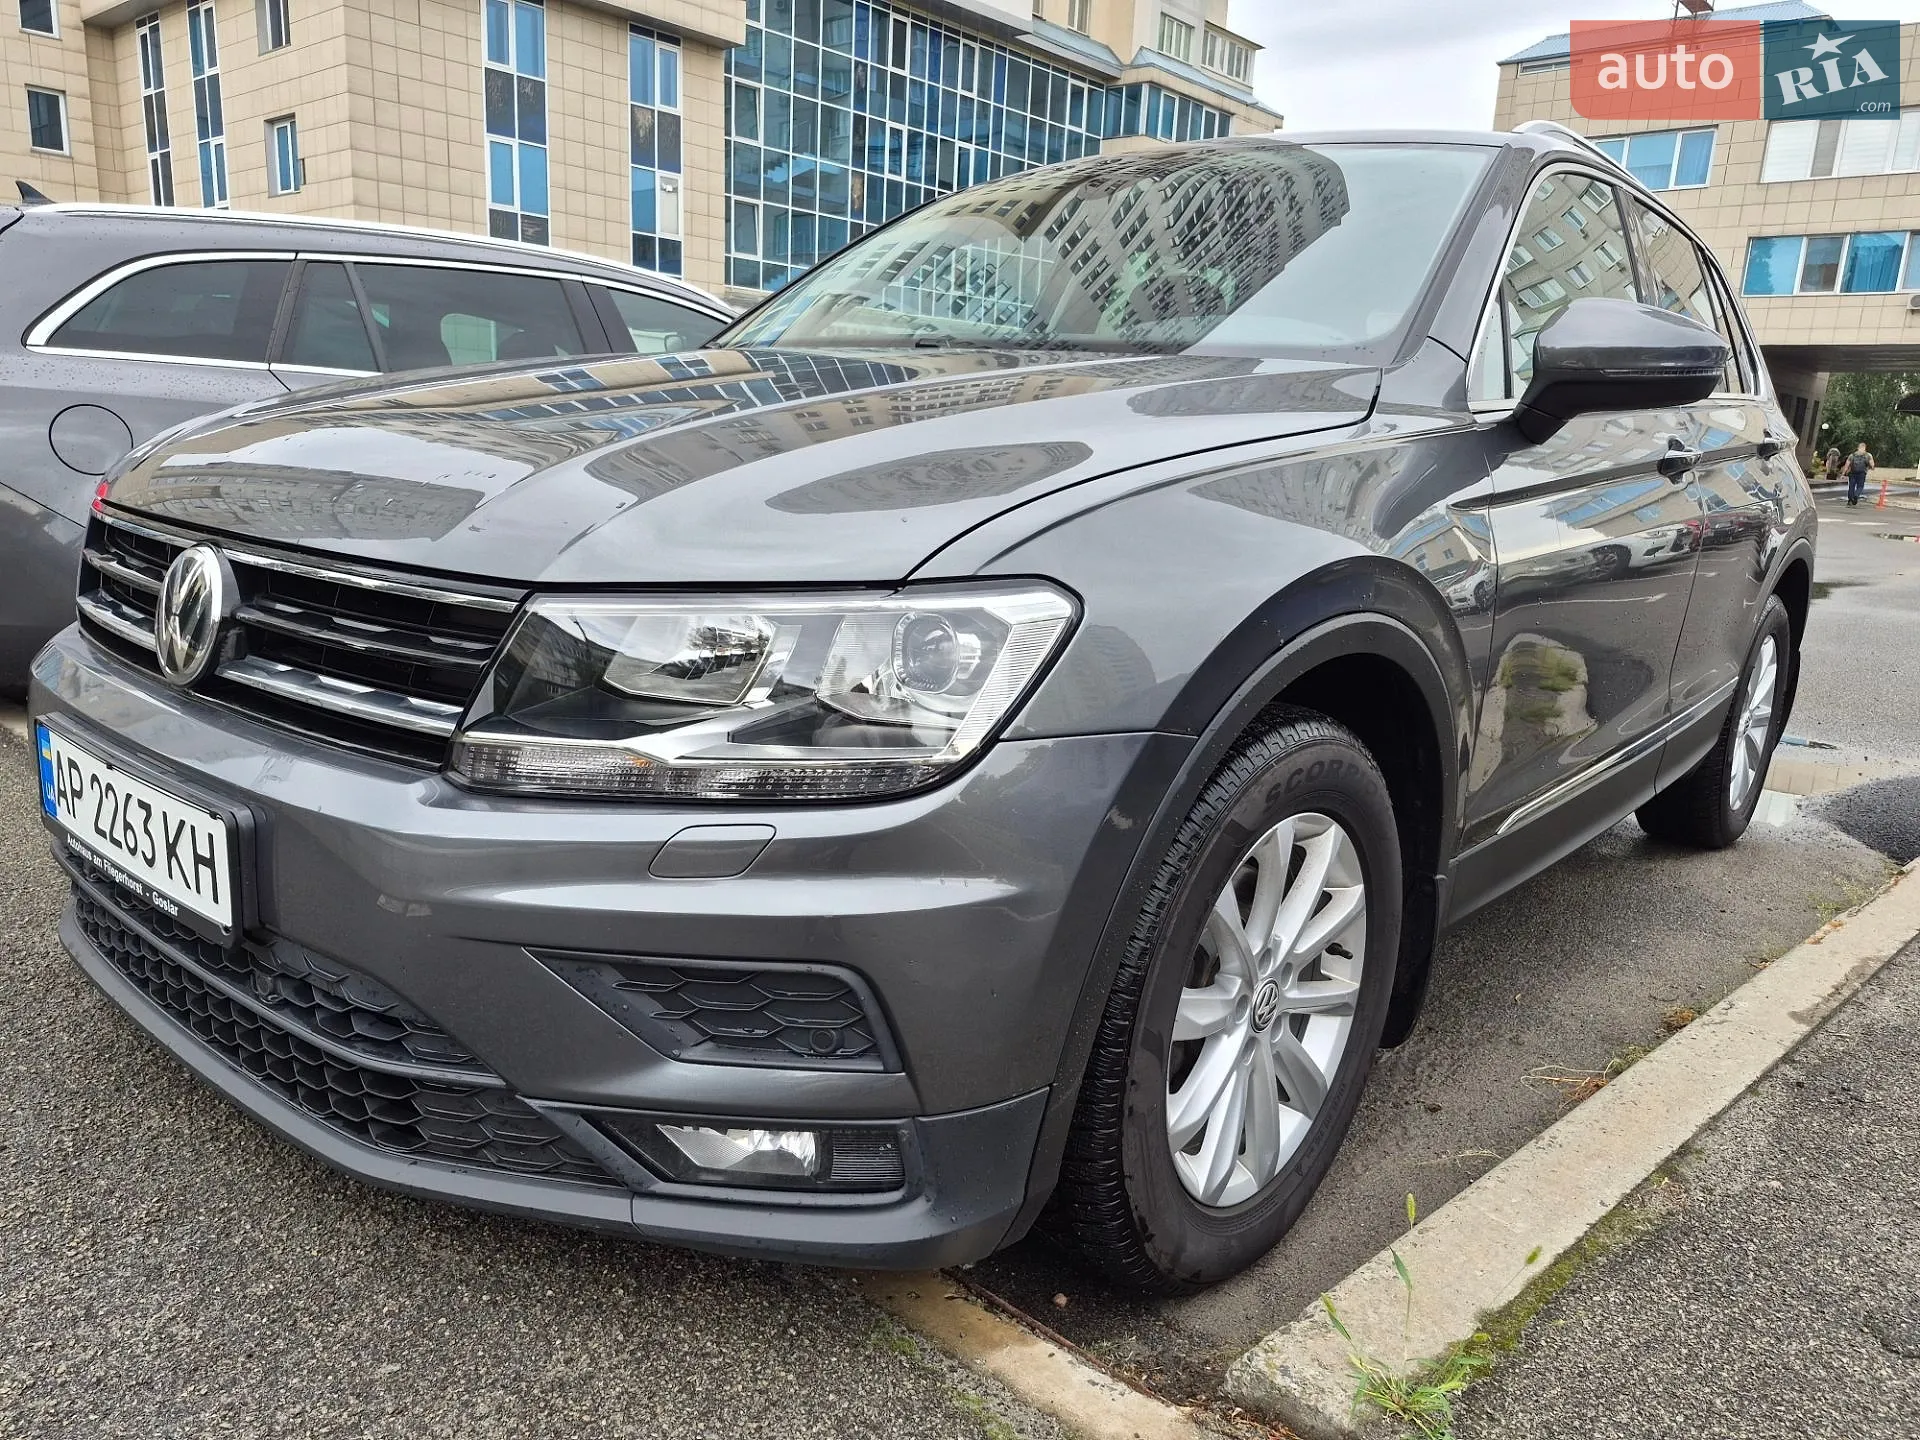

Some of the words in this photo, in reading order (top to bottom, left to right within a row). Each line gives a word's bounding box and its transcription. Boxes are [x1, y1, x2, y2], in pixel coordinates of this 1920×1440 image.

[56, 750, 84, 819] AP
[90, 772, 157, 869] 2263
[162, 811, 219, 905] KH
[152, 891, 179, 917] Goslar
